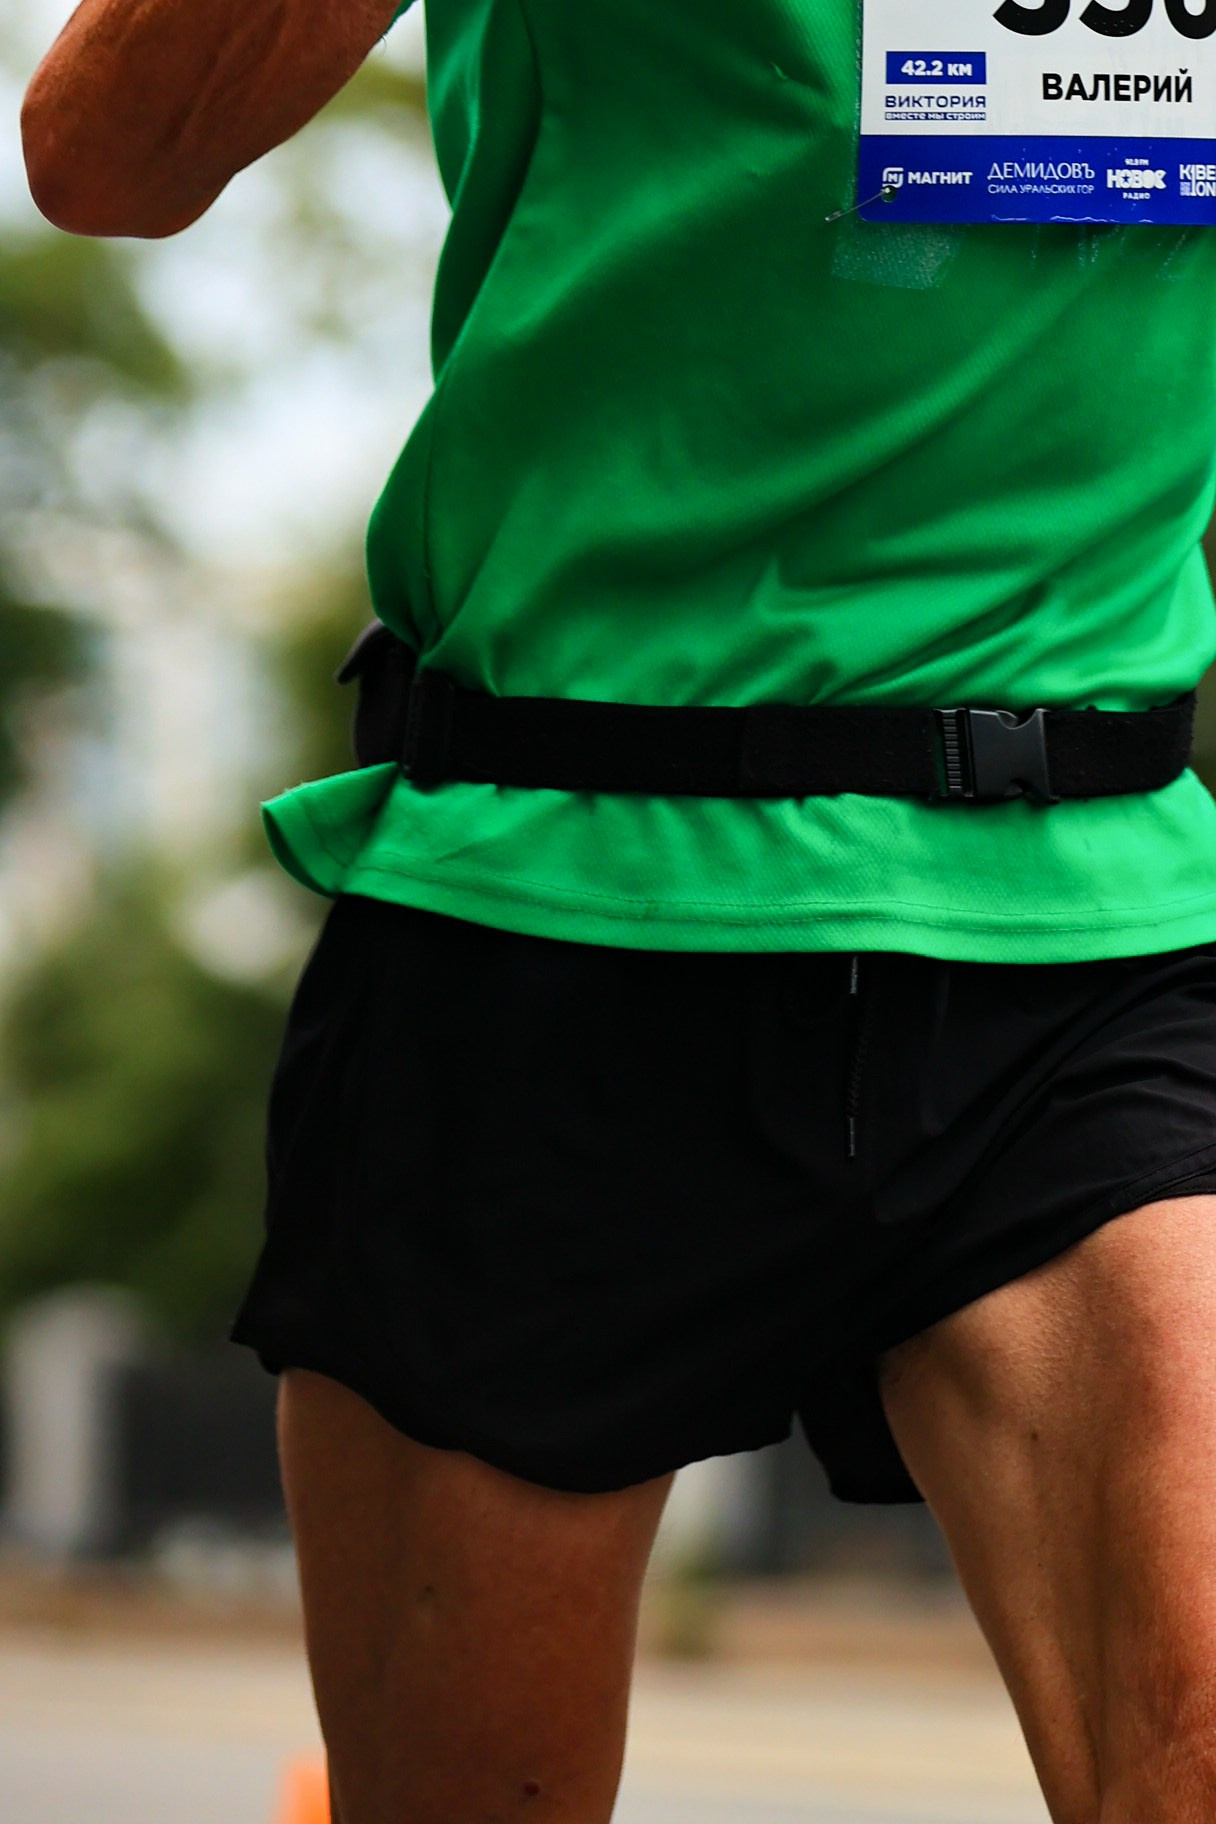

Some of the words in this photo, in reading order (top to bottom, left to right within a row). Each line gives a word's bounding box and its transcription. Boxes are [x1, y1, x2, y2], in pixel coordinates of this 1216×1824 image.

[901, 60, 944, 76] 42.2
[1042, 68, 1193, 103] ВАЛЕРИЙ
[885, 95, 987, 108] ВИКТОРИЯ
[987, 162, 1096, 180] ДЕМИДОВЪ
[908, 172, 973, 185] МАГНИТ
[988, 184, 1017, 194] СИЛА
[1077, 185, 1095, 194] ГОР
[1122, 192, 1151, 200] РАДИО
